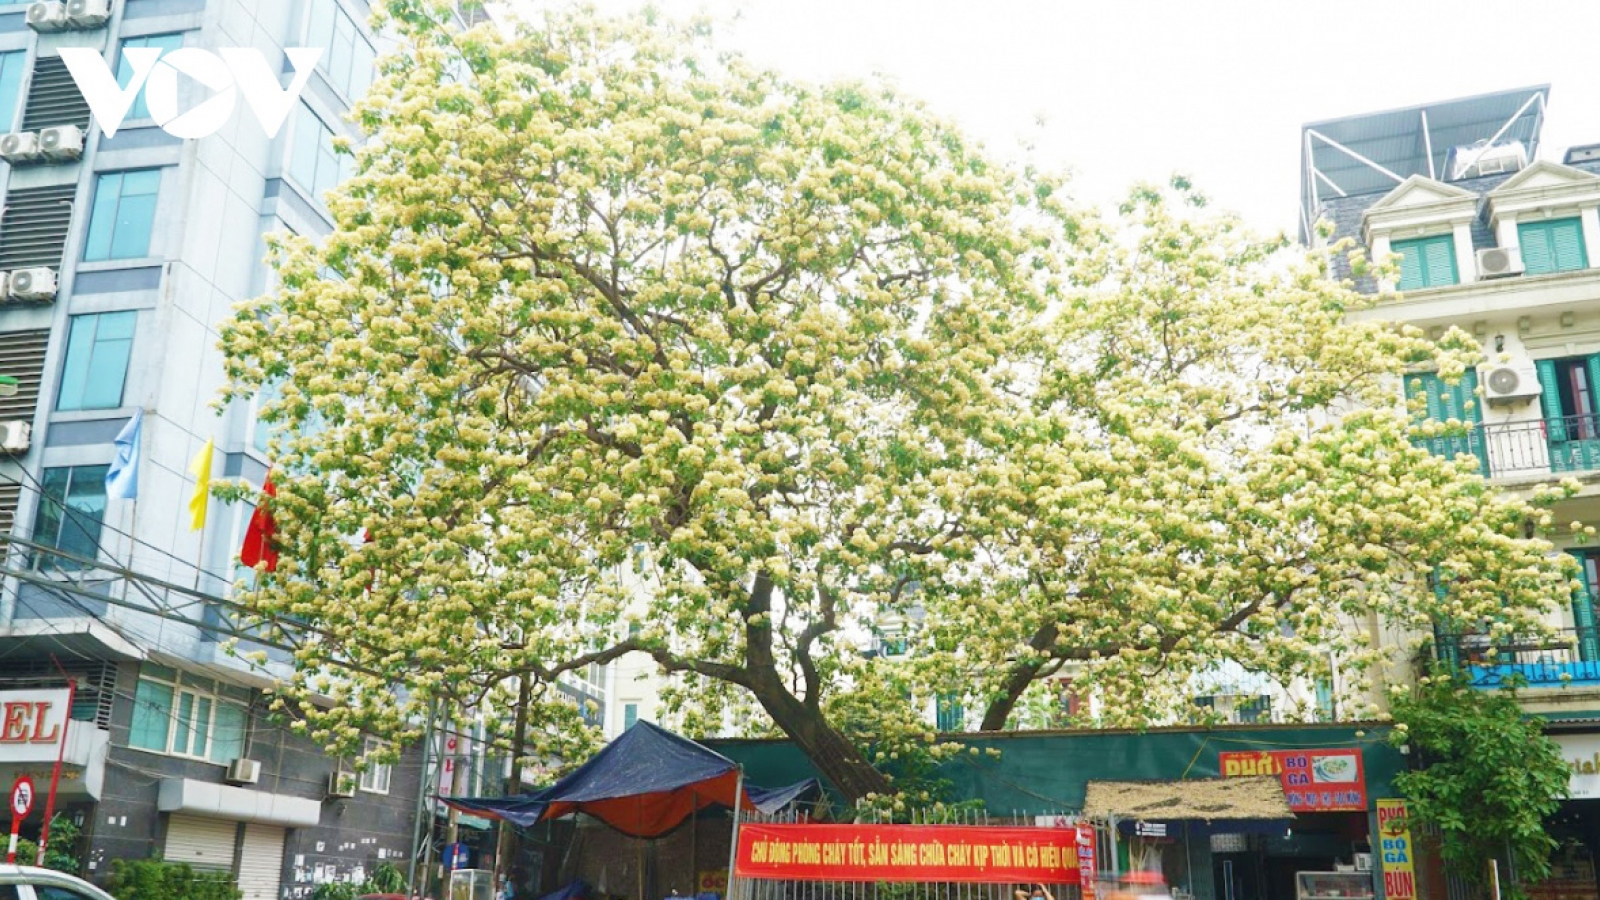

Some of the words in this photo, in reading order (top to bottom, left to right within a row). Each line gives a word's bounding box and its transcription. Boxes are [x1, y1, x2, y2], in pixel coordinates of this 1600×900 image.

[751, 835, 768, 863] CHỦ
[769, 837, 791, 868] ĐỘNG
[792, 837, 821, 864] PHÒNG
[823, 839, 846, 866] CHÁY
[848, 836, 867, 868] TỐT,
[868, 835, 889, 866] SẴN
[891, 839, 917, 866] SÀNG
[919, 839, 945, 866] CHỮA
[948, 839, 971, 867] CHÁY
[974, 844, 989, 871] KỊP
[990, 840, 1011, 867] THỜI
[1012, 841, 1025, 867] VÀ
[1027, 841, 1039, 868] CÓ
[1040, 842, 1060, 873] HIỆU
[1385, 866, 1414, 897] BÚN
